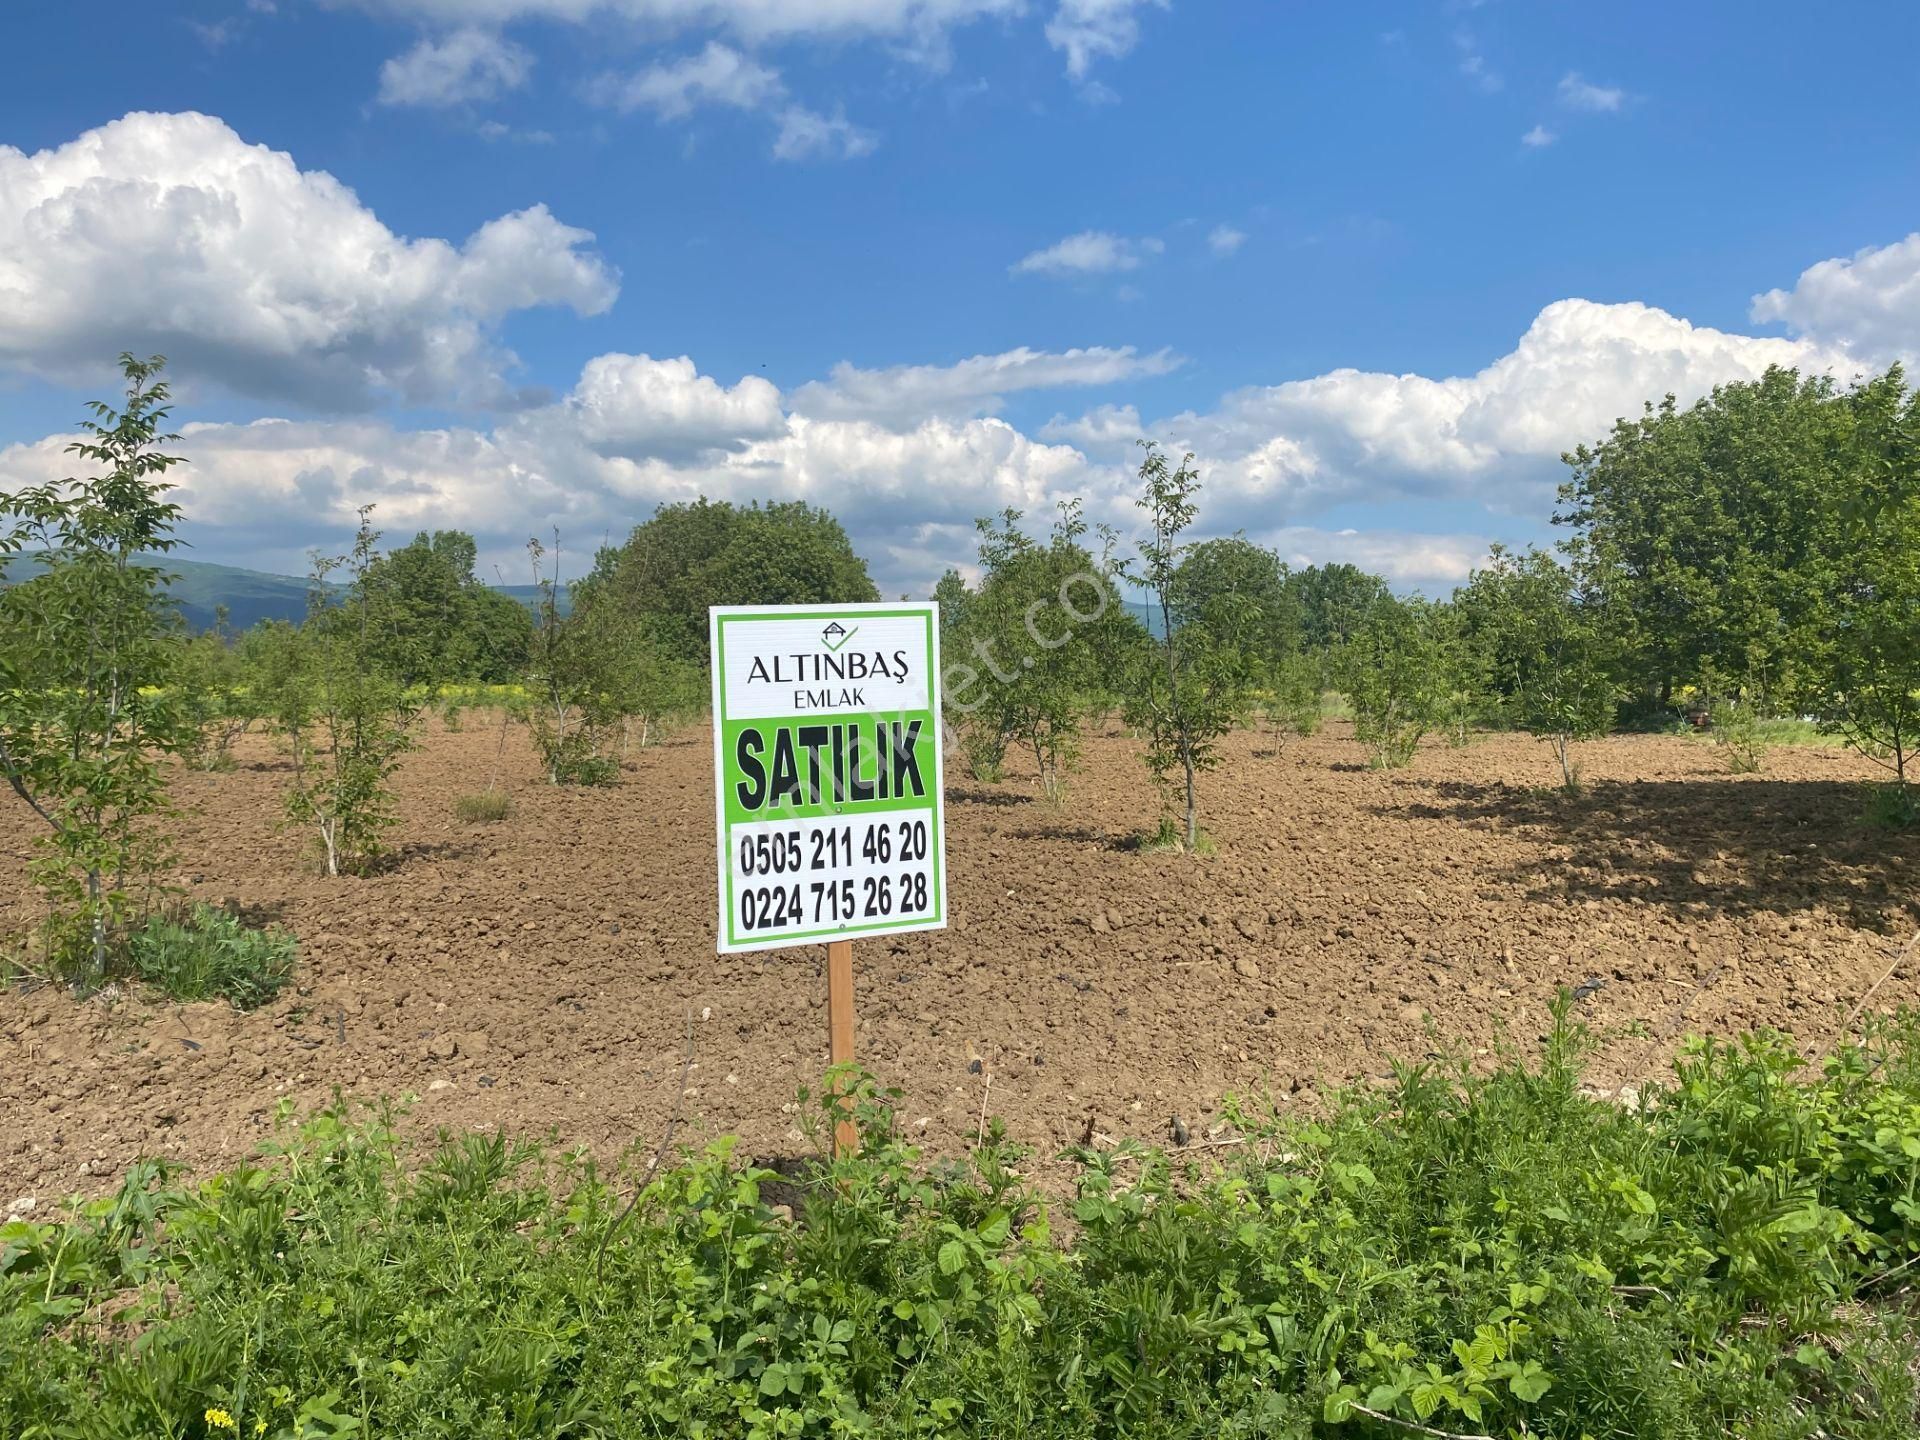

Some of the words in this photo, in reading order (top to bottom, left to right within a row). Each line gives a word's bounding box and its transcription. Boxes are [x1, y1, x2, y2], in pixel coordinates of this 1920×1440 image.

[747, 650, 909, 684] ALTINBAŞ
[794, 687, 866, 709] EMLAK
[736, 719, 926, 811] SATILIK
[740, 830, 801, 876] 0505
[810, 826, 851, 870] 211
[862, 823, 891, 864] 46
[899, 820, 926, 862] 20
[741, 883, 803, 930] 0224
[811, 878, 855, 922] 715
[863, 875, 892, 917] 26
[900, 871, 927, 913] 28
